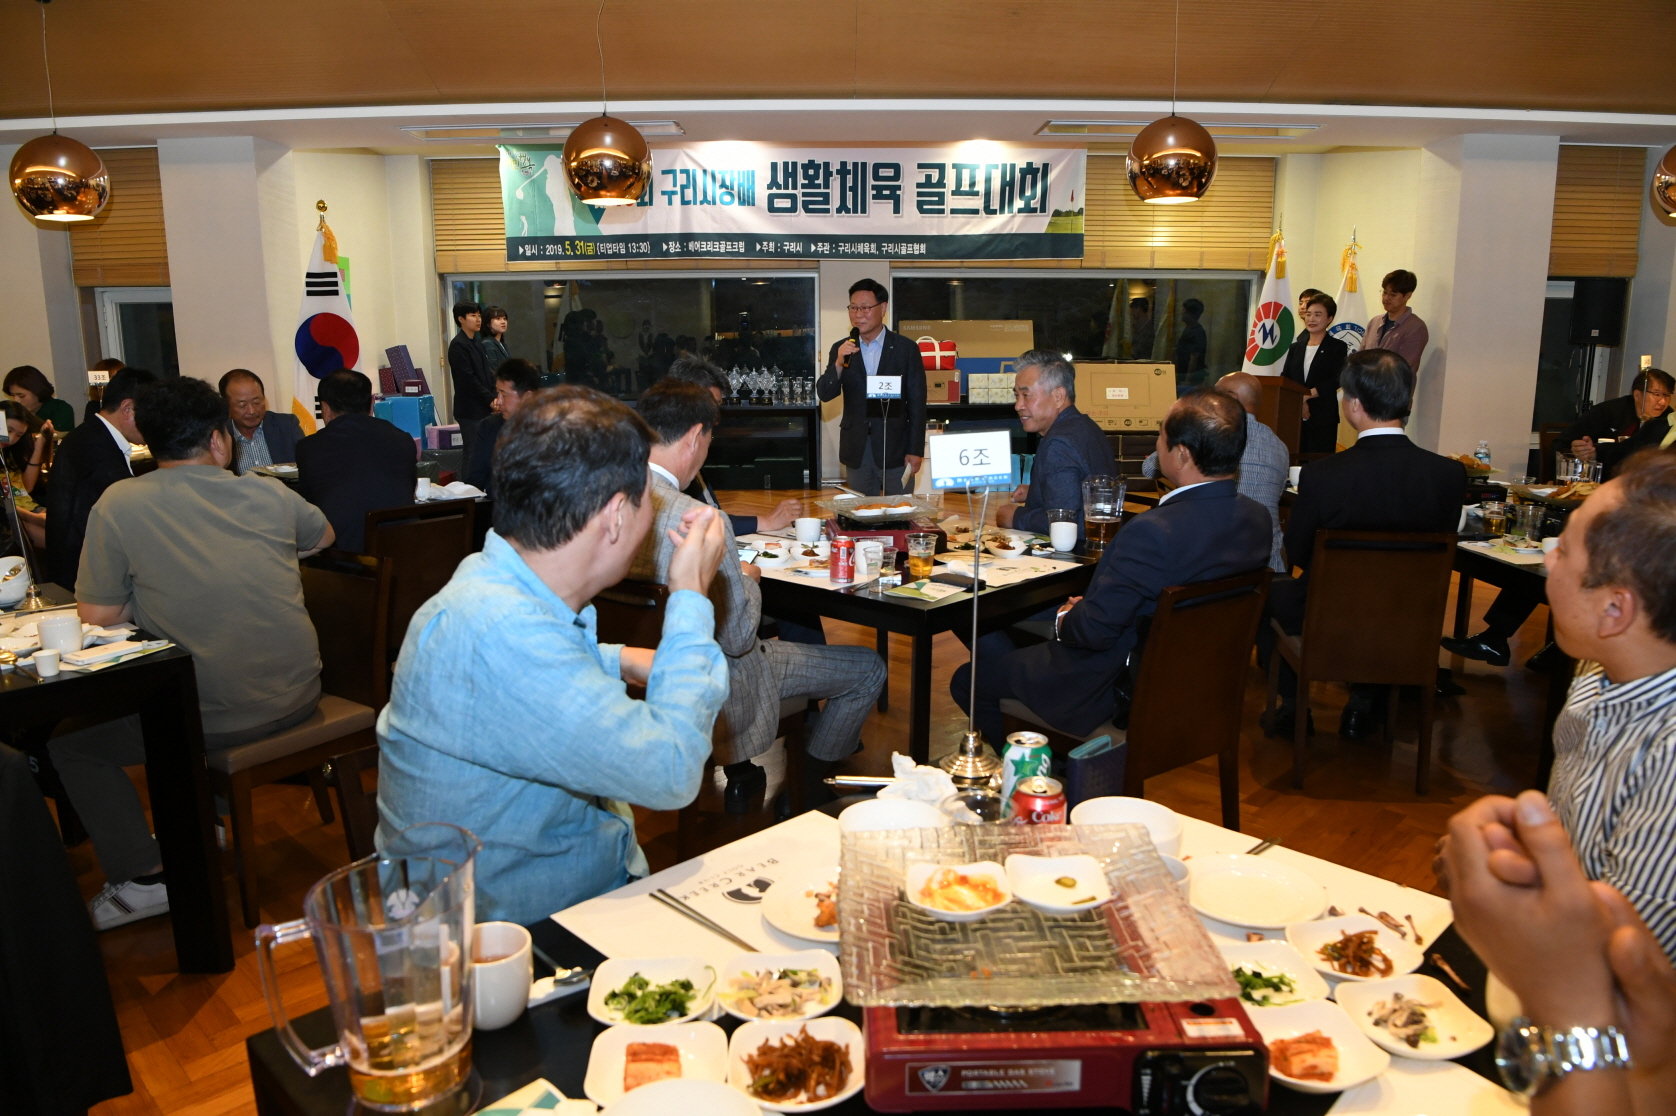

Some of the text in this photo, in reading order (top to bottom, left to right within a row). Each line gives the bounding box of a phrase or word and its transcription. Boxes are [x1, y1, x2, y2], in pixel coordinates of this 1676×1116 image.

[661, 160, 1050, 215] 구리시장배 생활체육 골프대회
[524, 243, 538, 256] 일시
[668, 241, 682, 253] 장소
[761, 241, 775, 253] 주최
[782, 241, 803, 253] 구리시
[816, 242, 830, 254] 주관
[881, 242, 927, 255] 구리시골프협회
[878, 381, 893, 391] 2조
[959, 448, 991, 467] 6조
[1032, 810, 1062, 823] Coke
